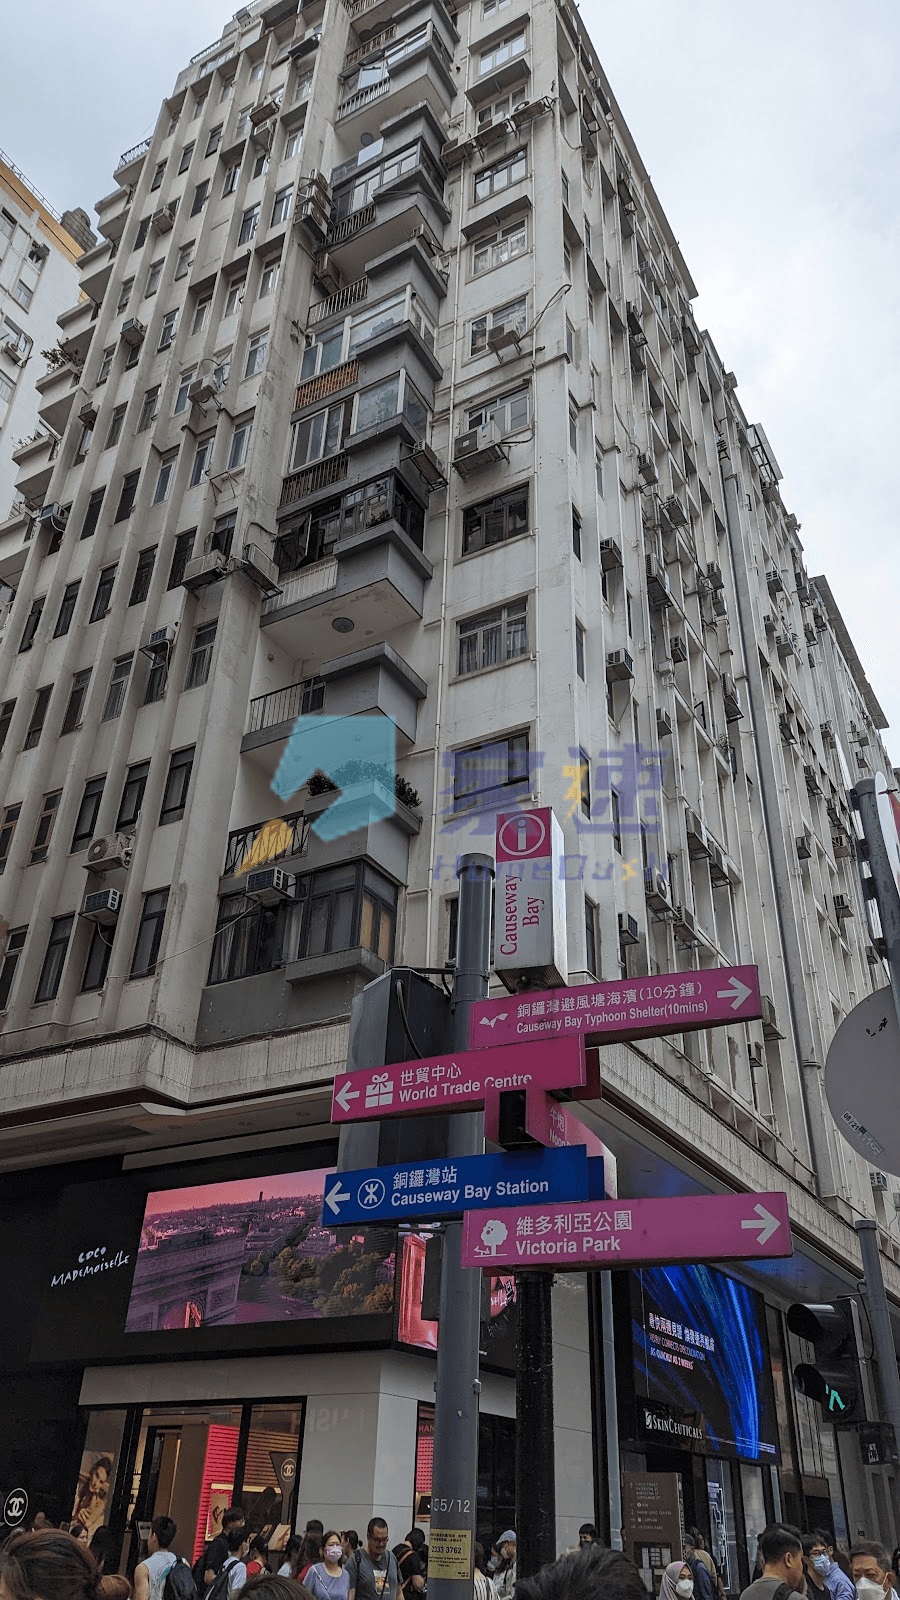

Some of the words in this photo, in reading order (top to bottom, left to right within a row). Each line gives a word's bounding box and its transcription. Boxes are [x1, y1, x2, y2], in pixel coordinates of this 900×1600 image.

[500, 875, 522, 956] Causeway
[522, 897, 545, 927] Bay
[516, 981, 703, 1019] 銅鑼灣避風塘海濱(10分鐘)
[516, 1017, 563, 1034] Causeway
[564, 1014, 583, 1029] Bay
[584, 1009, 627, 1027] Typhoon
[629, 999, 709, 1020] Shelter(10mins)
[400, 1062, 462, 1087] 世貿中心
[399, 1085, 437, 1103] World
[442, 1079, 481, 1096] Trade
[392, 1165, 458, 1191] 銅鑼灣站
[390, 1189, 460, 1208] Causeway
[464, 1184, 492, 1201] Bay
[495, 1178, 549, 1196] Station
[515, 1209, 633, 1237] 維多利亞公園
[515, 1238, 578, 1256] Victoria
[582, 1235, 622, 1252] Park
